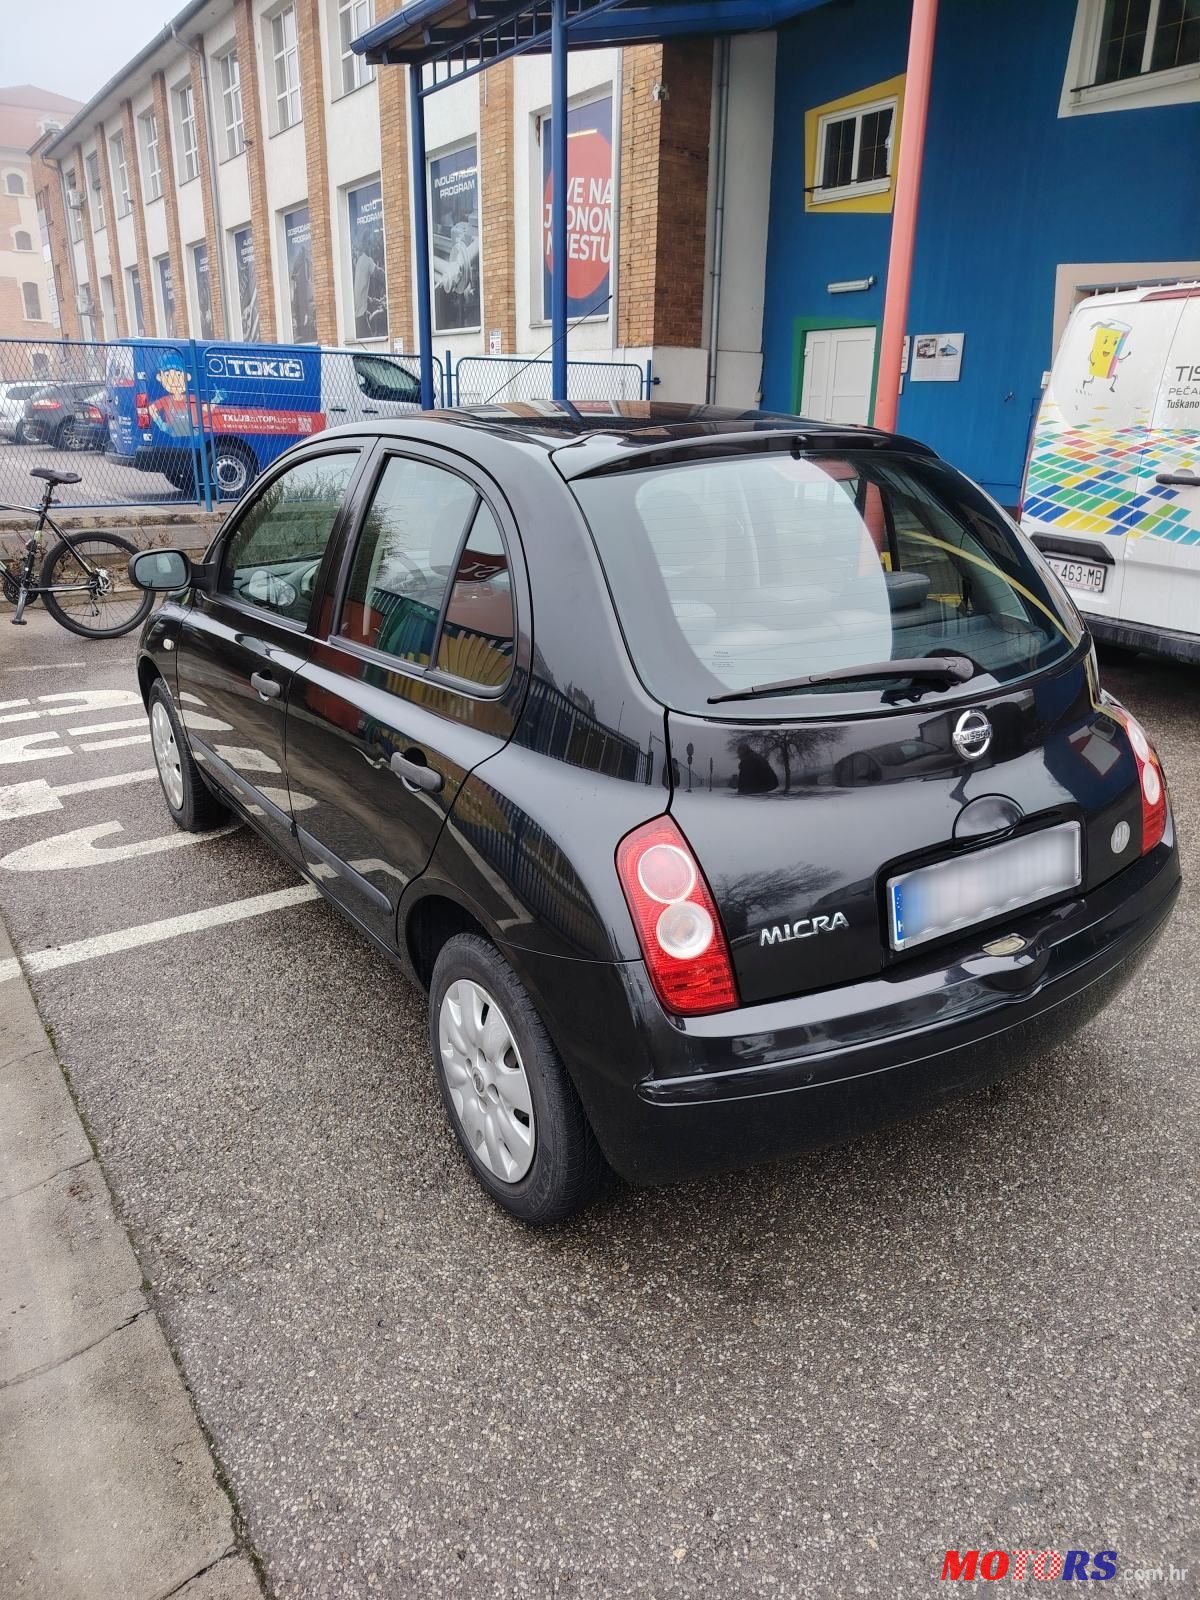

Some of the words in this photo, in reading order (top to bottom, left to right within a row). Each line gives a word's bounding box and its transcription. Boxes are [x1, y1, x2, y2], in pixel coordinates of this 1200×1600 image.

[439, 179, 475, 198] PROGRAM
[1061, 563, 1103, 587] 463-MB
[760, 911, 850, 947] MICRA
